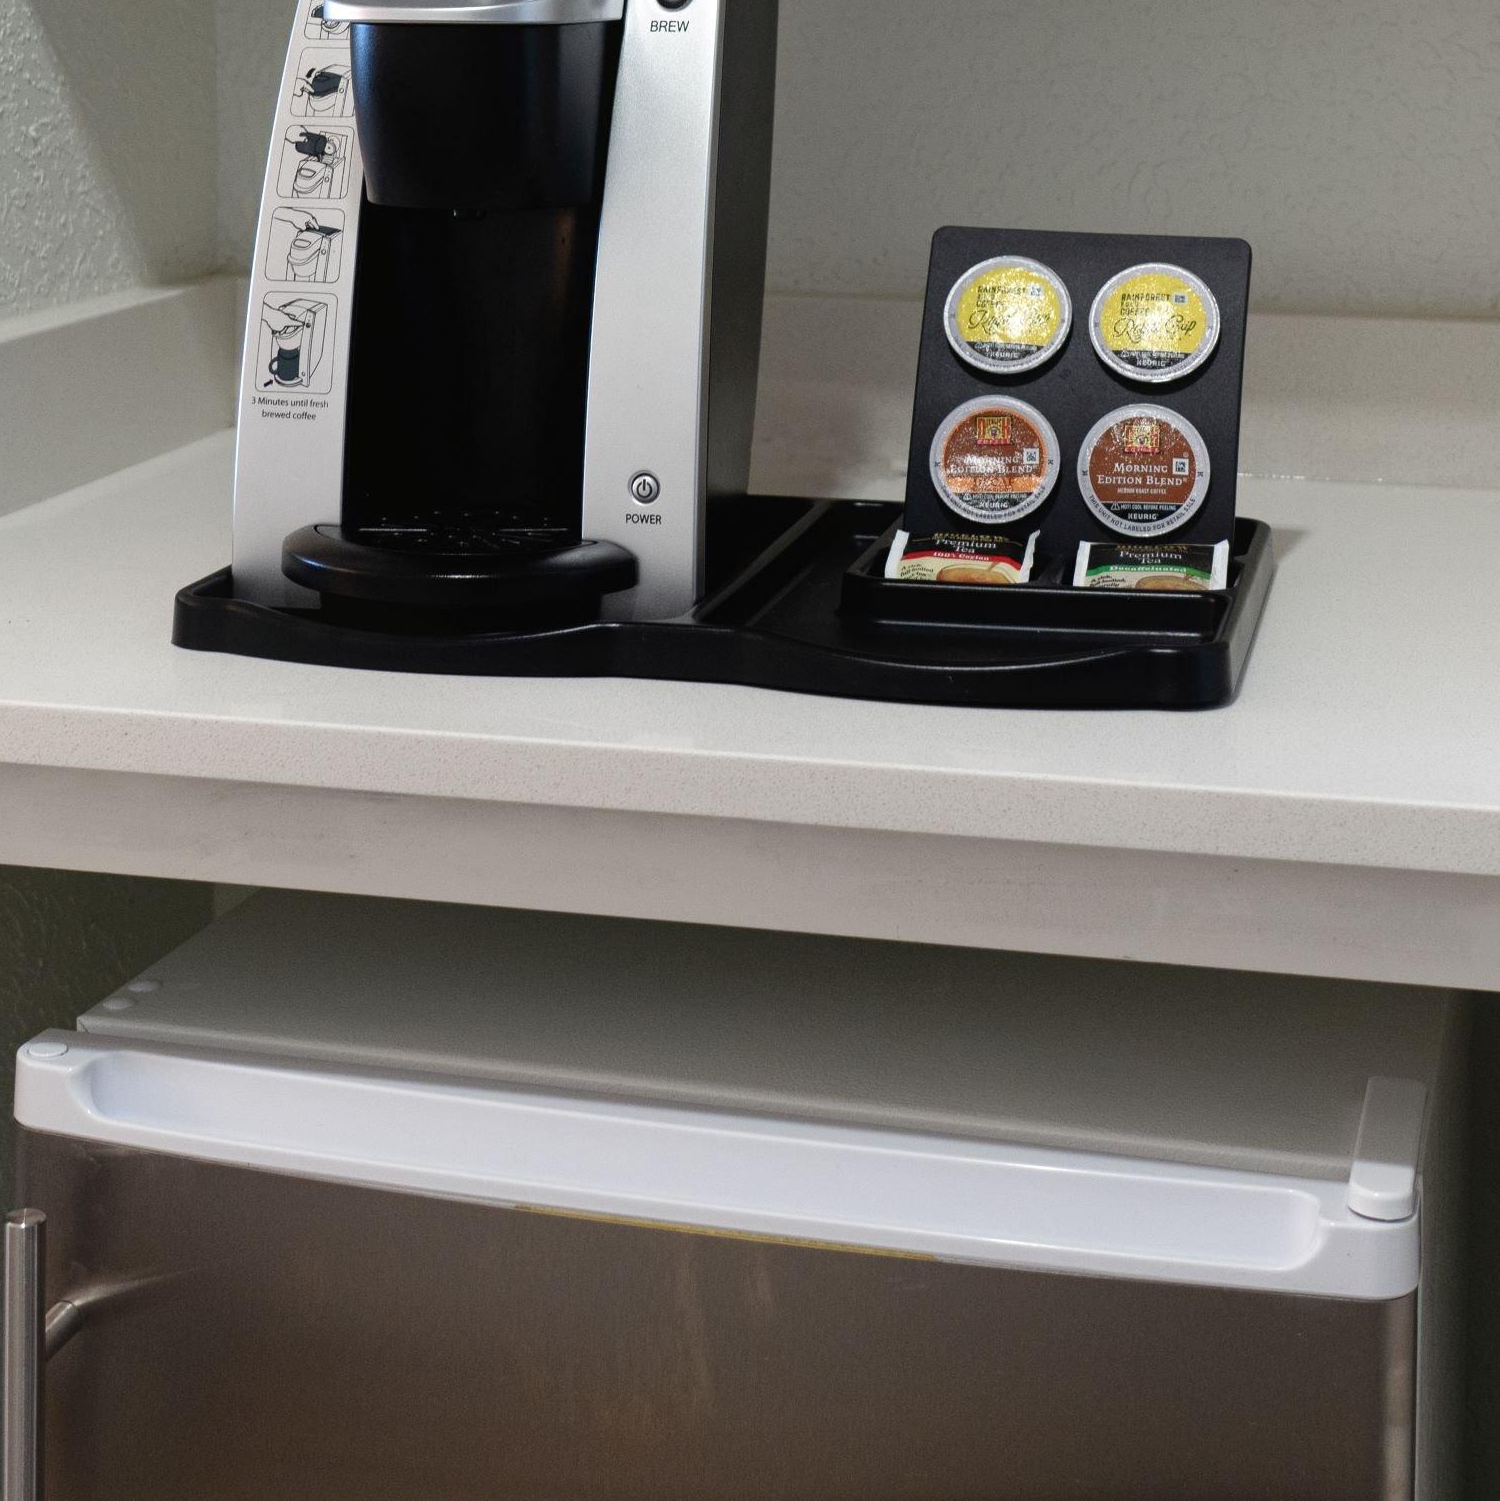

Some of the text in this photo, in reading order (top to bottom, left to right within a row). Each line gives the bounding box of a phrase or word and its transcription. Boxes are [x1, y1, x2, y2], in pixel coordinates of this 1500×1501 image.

[649, 20, 690, 33] BREW
[251, 396, 329, 409] 3 Minutes until fresh
[261, 409, 317, 421] brewed coffee
[625, 513, 662, 525] POWER
[1127, 512, 1157, 520] KEURIG
[1152, 521, 1166, 531] FOR
